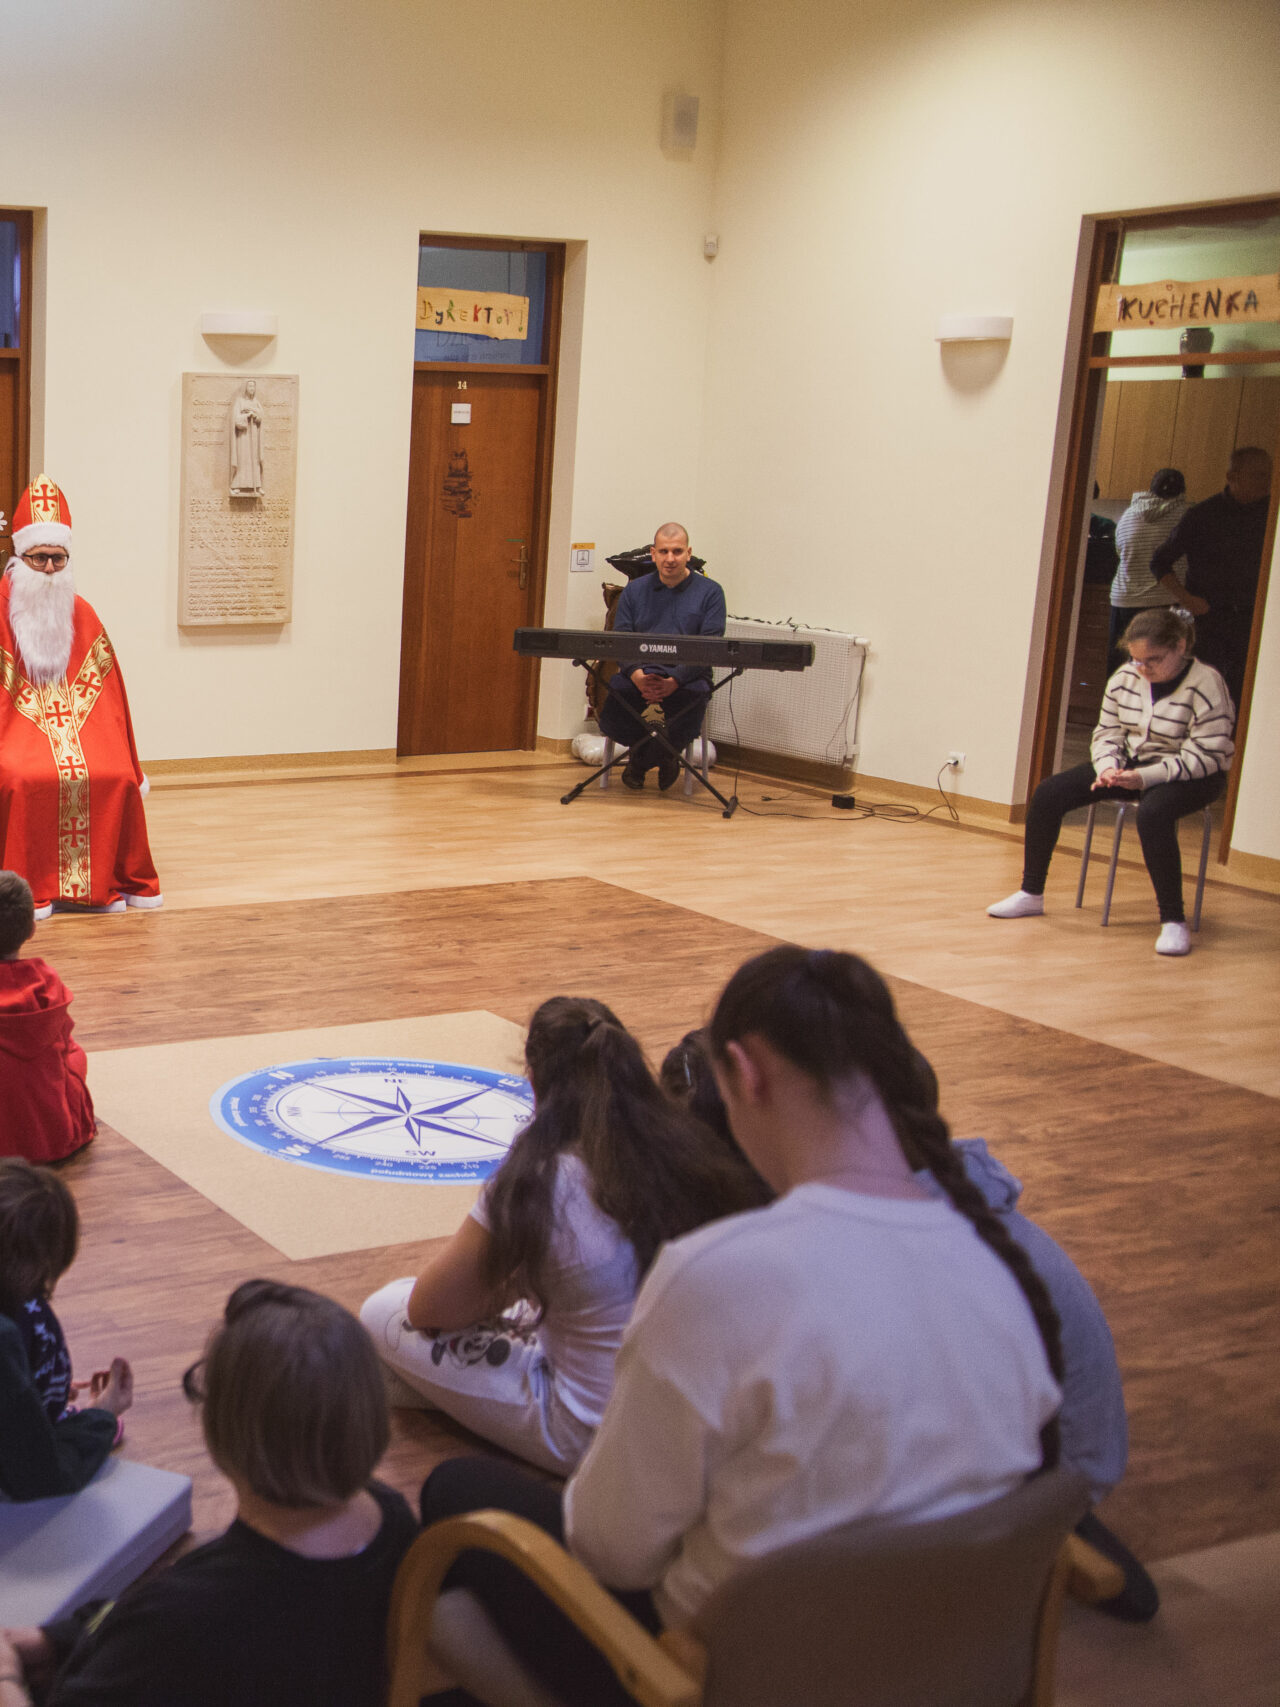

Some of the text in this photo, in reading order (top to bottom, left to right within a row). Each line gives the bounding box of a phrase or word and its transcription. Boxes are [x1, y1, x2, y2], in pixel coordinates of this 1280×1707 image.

[1118, 288, 1259, 322] KUCHENKA
[457, 380, 468, 390] 14
[648, 644, 677, 654] YAMAHA
